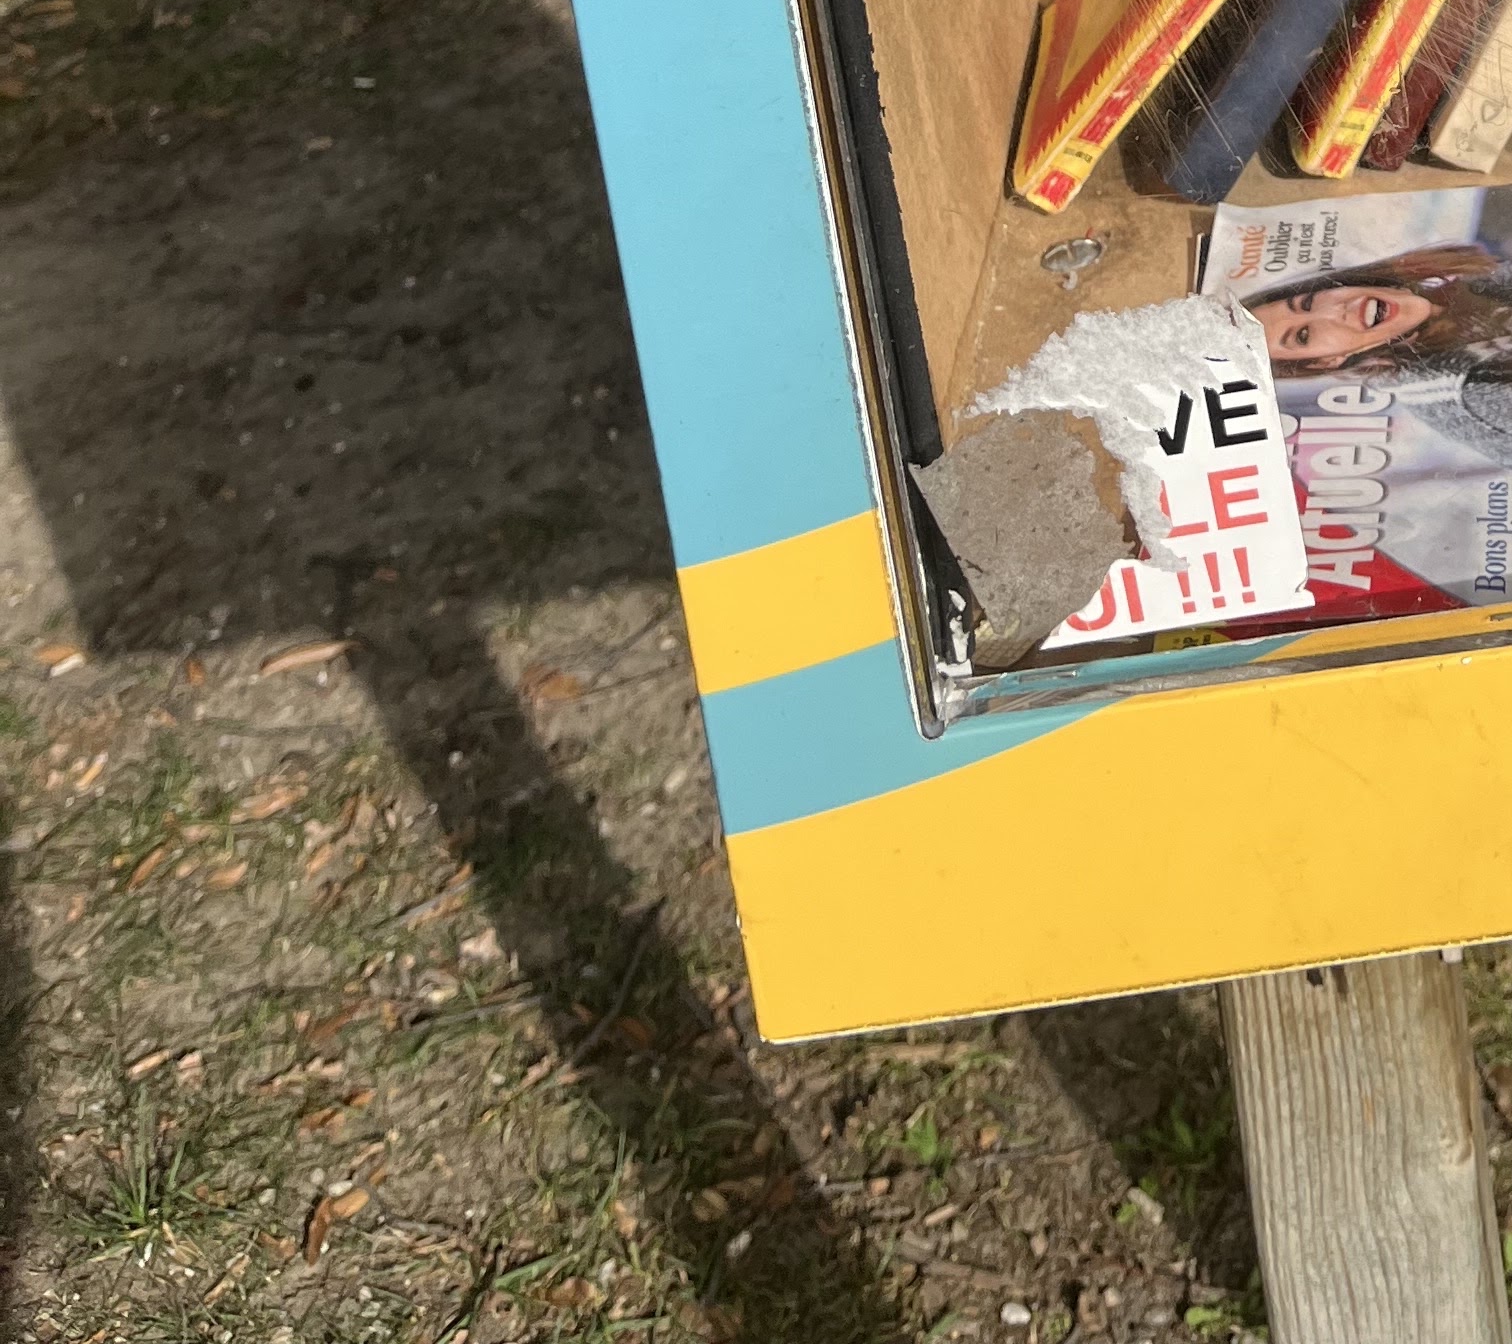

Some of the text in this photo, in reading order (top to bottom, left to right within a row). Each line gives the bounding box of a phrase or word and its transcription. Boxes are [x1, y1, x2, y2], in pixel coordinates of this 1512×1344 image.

[1228, 224, 1267, 279] Santé
[1264, 221, 1293, 272] Oublier
[1318, 249, 1337, 271] pas
[1297, 384, 1394, 591] Actuelle
[1474, 540, 1508, 594] Bons
